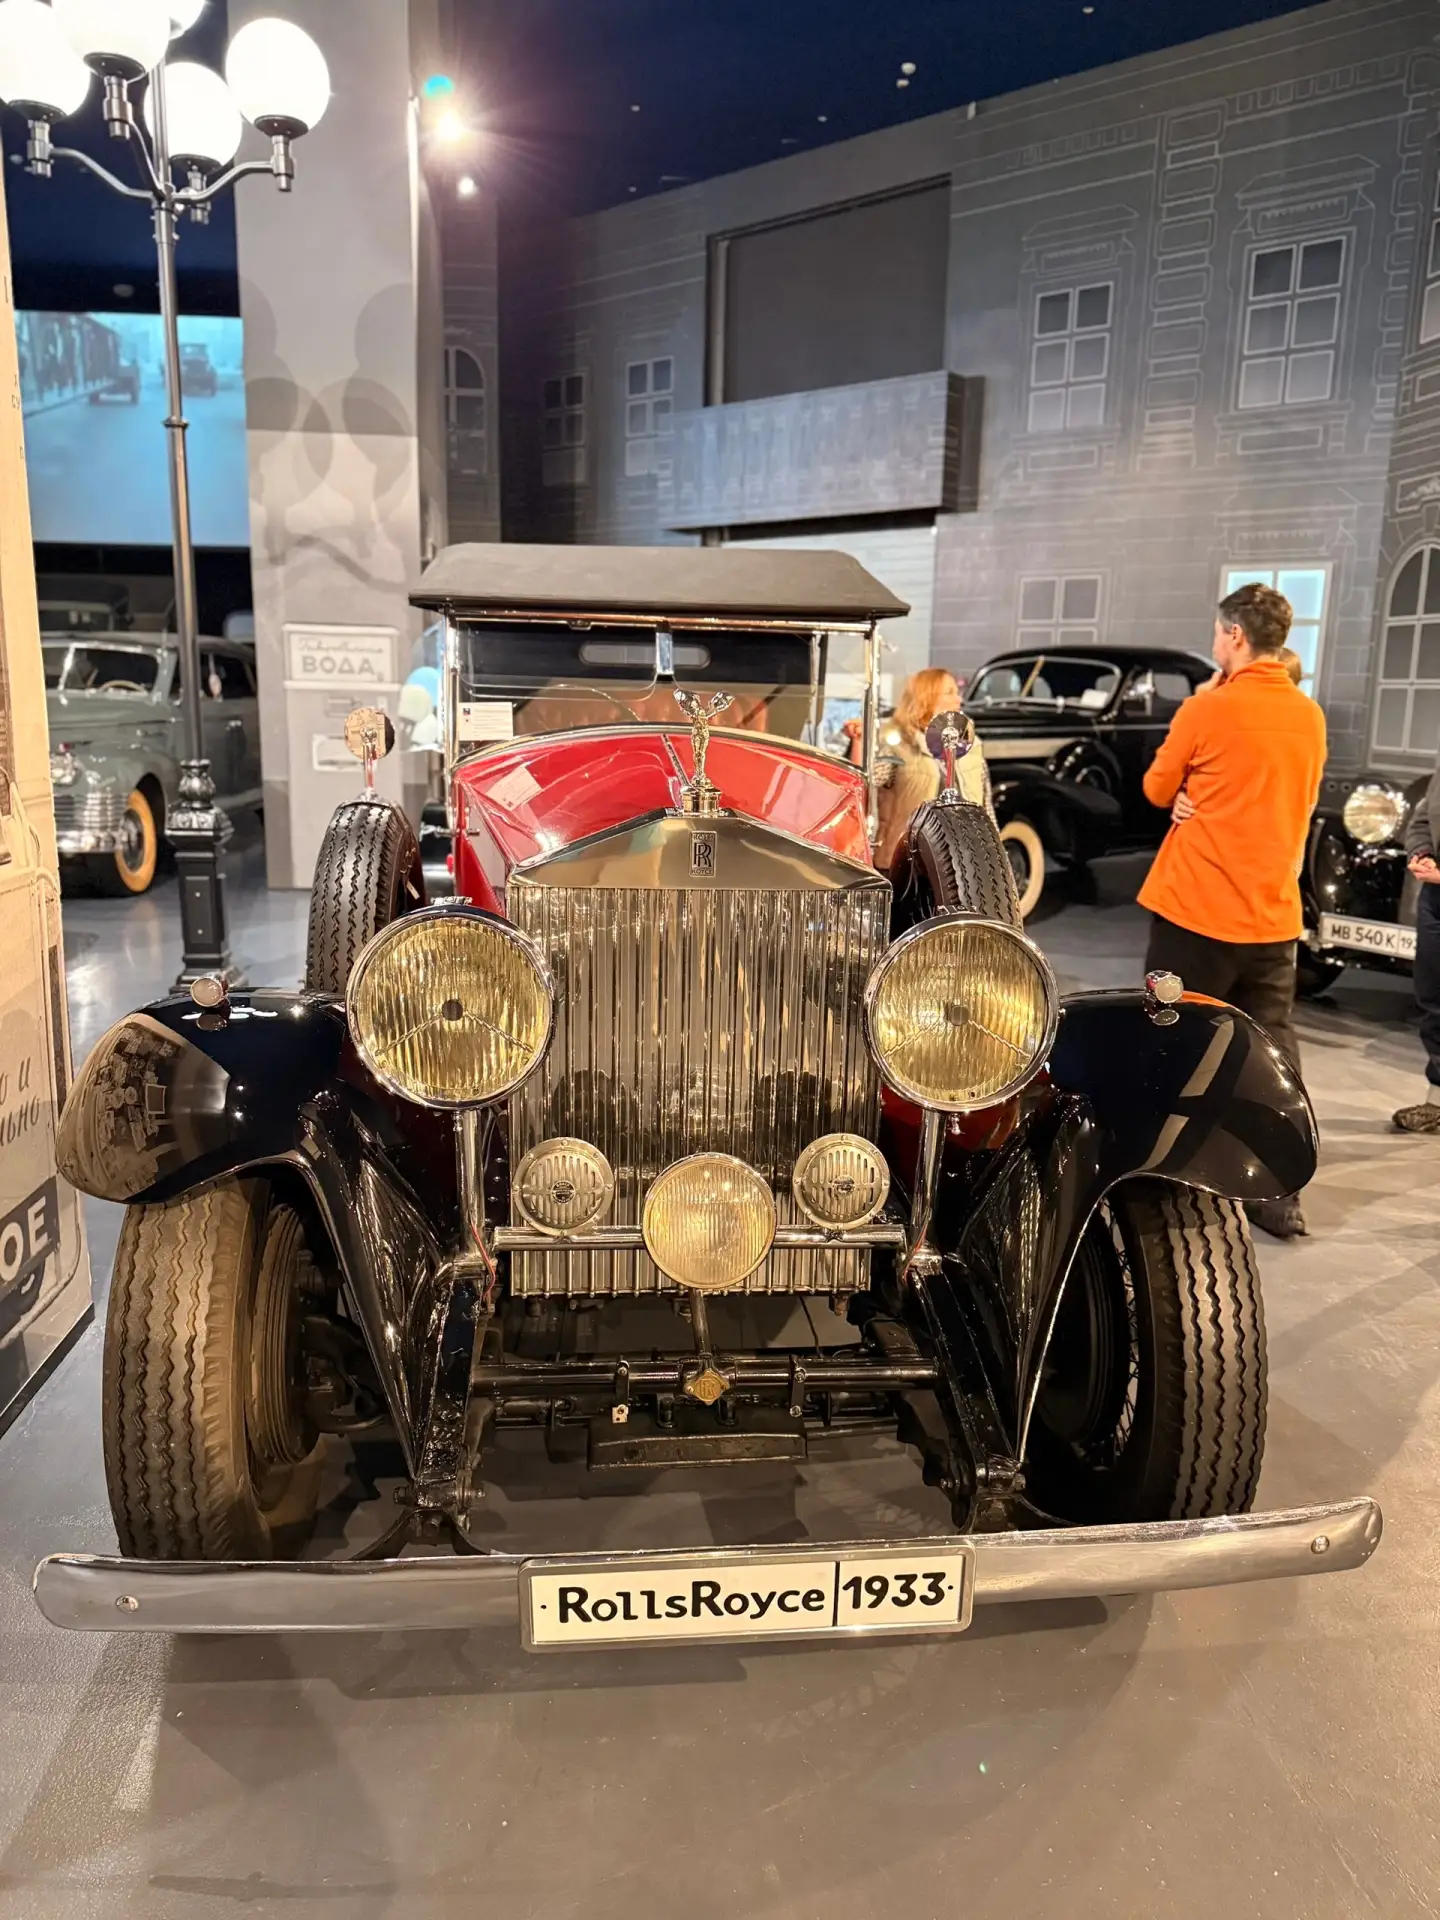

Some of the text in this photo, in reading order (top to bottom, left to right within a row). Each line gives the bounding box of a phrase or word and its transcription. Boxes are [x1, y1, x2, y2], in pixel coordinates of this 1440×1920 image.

[302, 655, 375, 675] ВОДА
[1331, 923, 1417, 950] MB 540 K 19
[558, 1571, 947, 1623] RollsRoyce 1933
